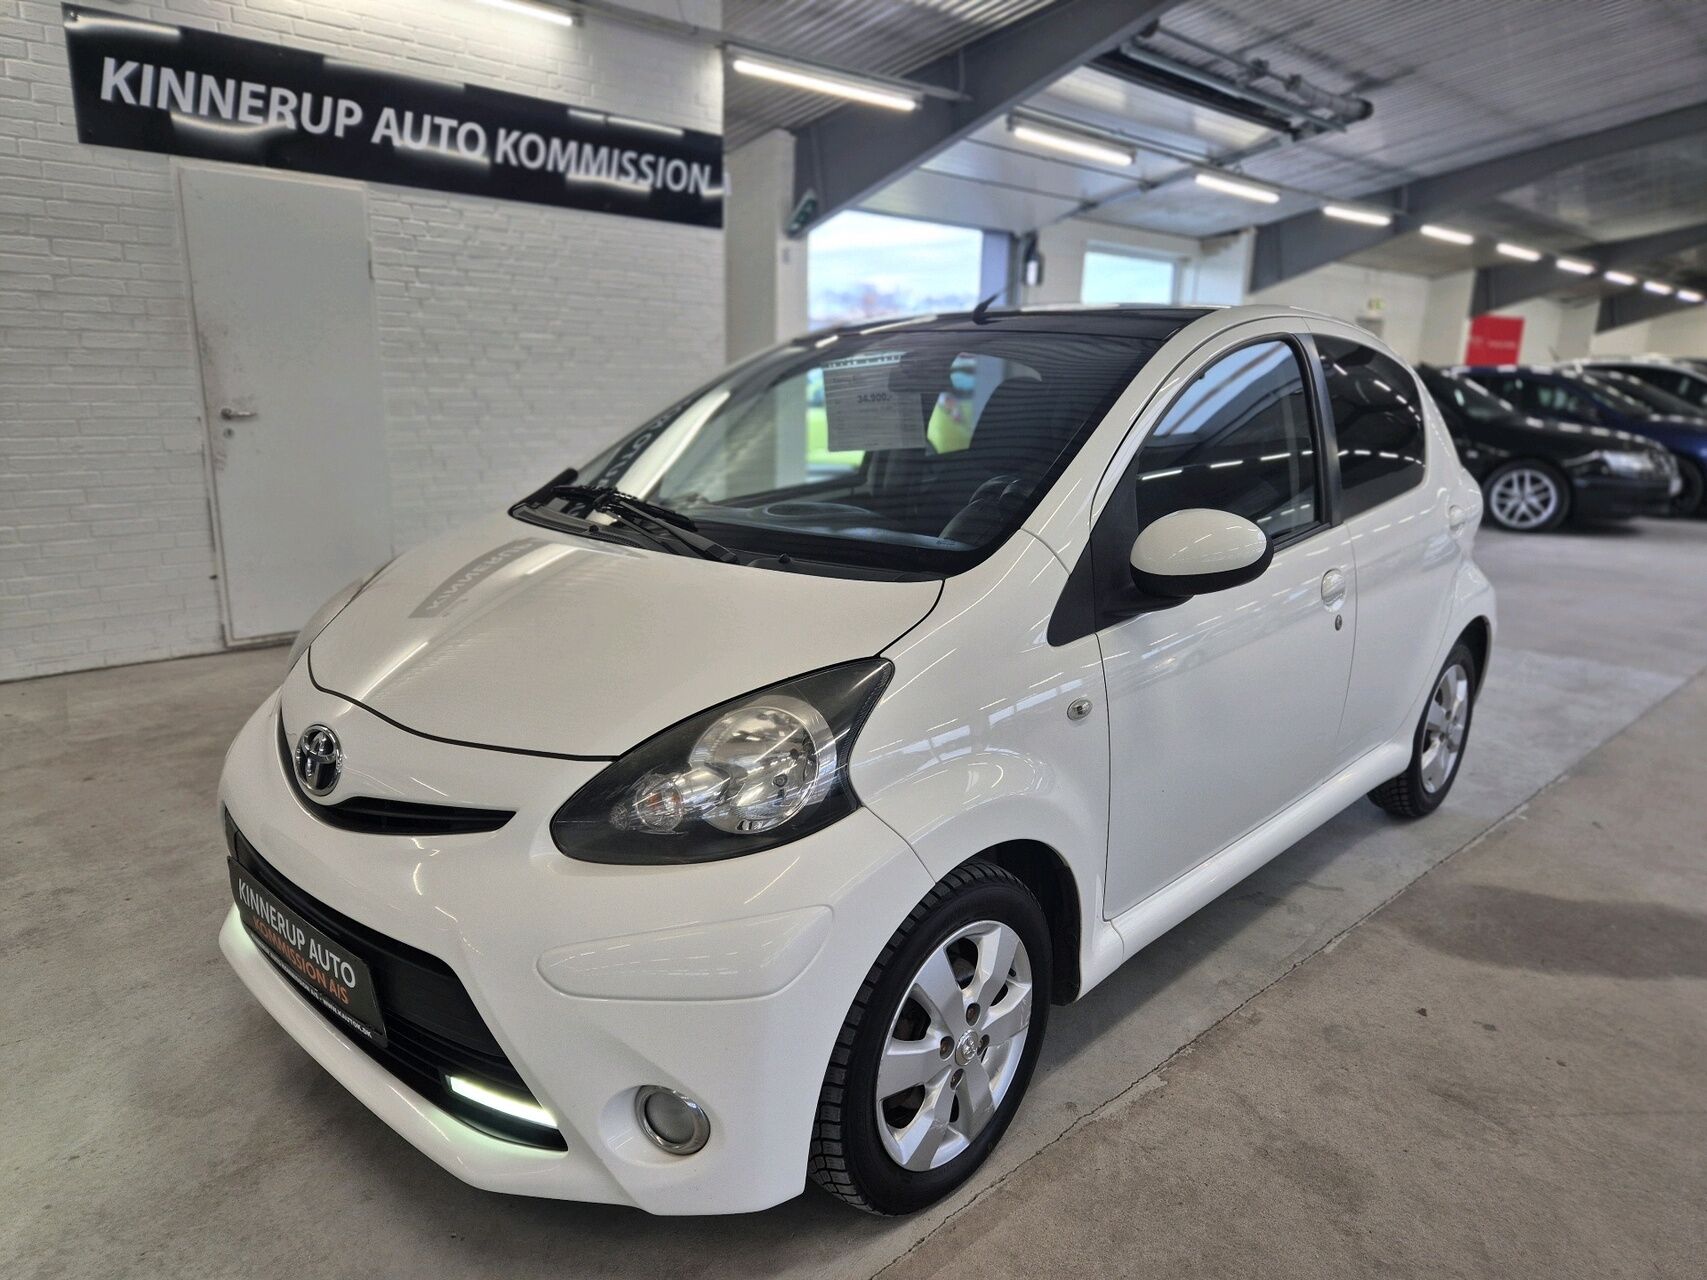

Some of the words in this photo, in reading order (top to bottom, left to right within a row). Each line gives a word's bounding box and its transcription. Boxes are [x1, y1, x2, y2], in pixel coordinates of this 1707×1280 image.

[99, 55, 363, 138] KINNERUP
[371, 107, 488, 160] AUTO
[494, 127, 713, 196] KOMMISSION
[238, 878, 305, 951] KINNERUP
[309, 938, 356, 989] AUTO
[253, 915, 328, 990] KOMMISSION
